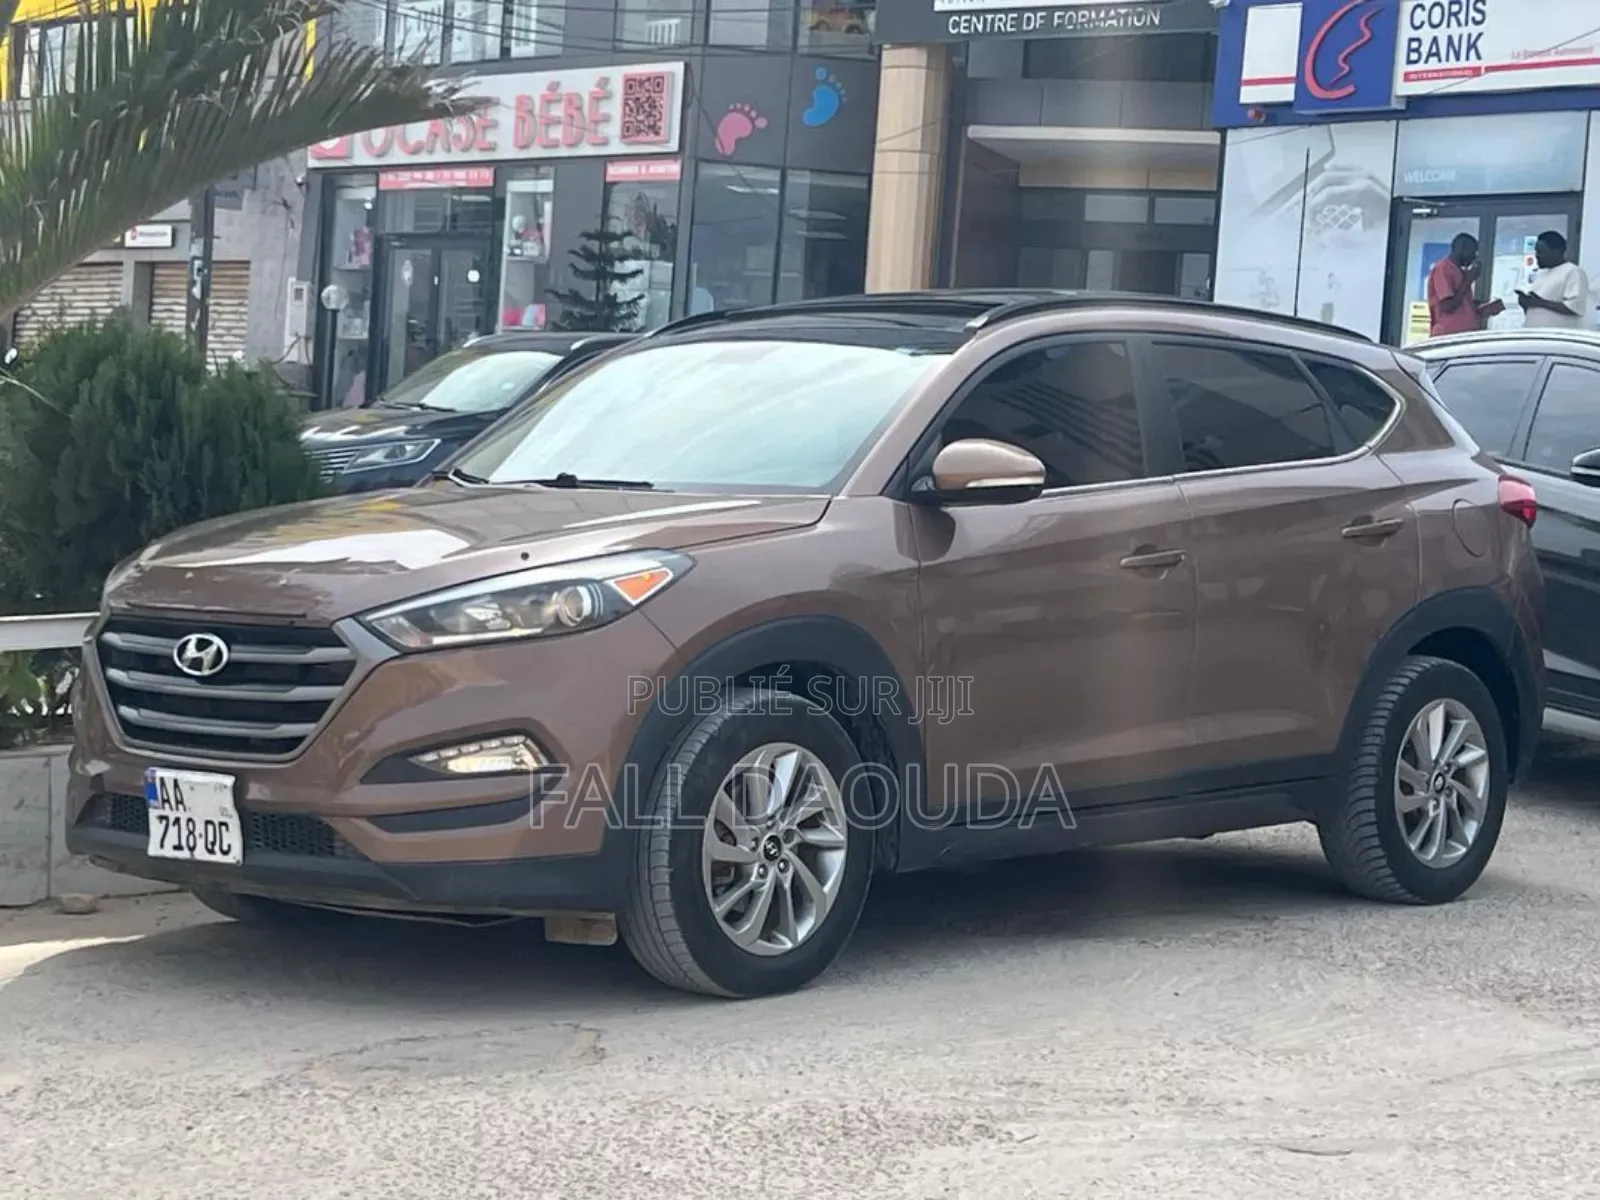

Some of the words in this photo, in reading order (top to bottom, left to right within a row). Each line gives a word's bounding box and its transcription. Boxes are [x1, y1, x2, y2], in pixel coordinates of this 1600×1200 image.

[948, 13, 1018, 34] CENTRE
[1053, 8, 1161, 29] FORMATION
[1409, 0, 1487, 31] CORIS
[1405, 32, 1485, 65] BANK
[513, 76, 613, 150] BÉBÉ
[159, 777, 187, 812] AA
